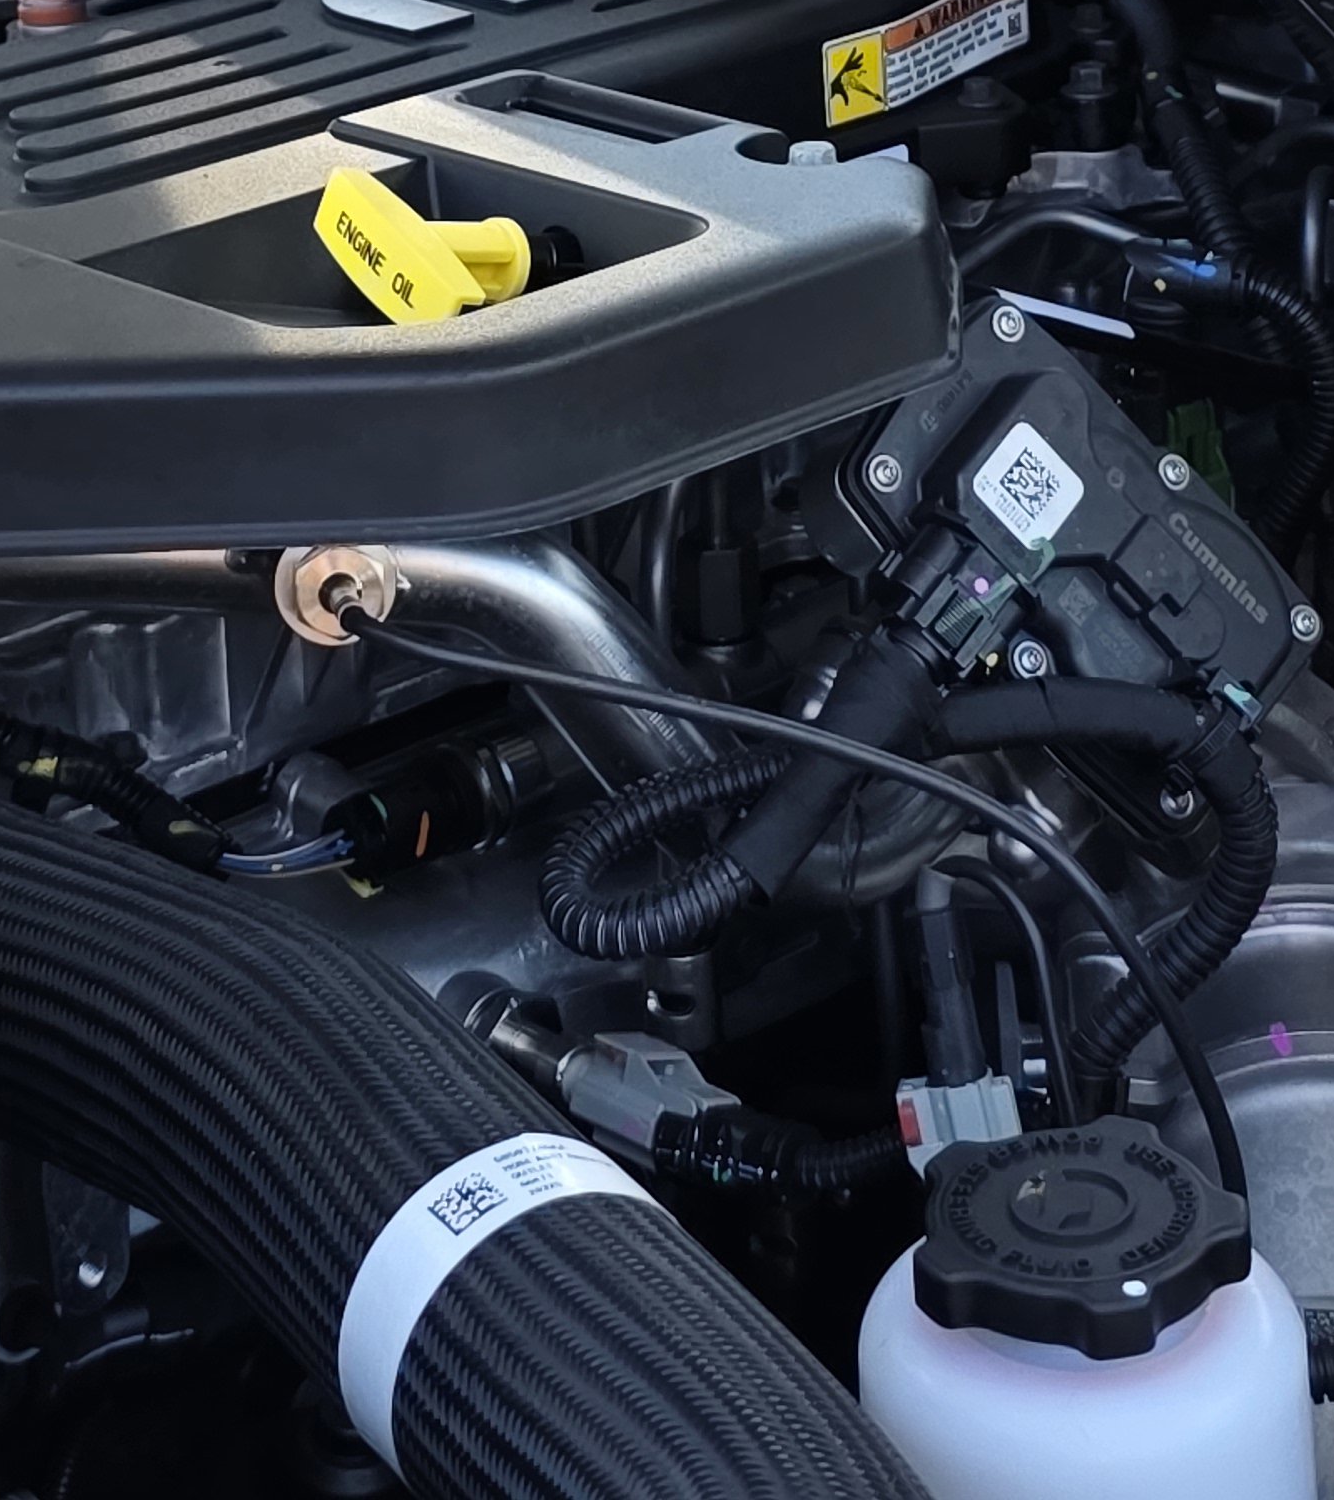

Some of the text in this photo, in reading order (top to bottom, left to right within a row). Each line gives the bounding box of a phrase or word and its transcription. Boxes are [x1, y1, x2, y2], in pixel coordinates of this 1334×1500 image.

[336, 211, 415, 309] ENGINE OIL
[1169, 512, 1269, 625] Cummins
[949, 1131, 1104, 1277] POWER STEERING FLUID
[1119, 1141, 1200, 1271] USE APPROVED
